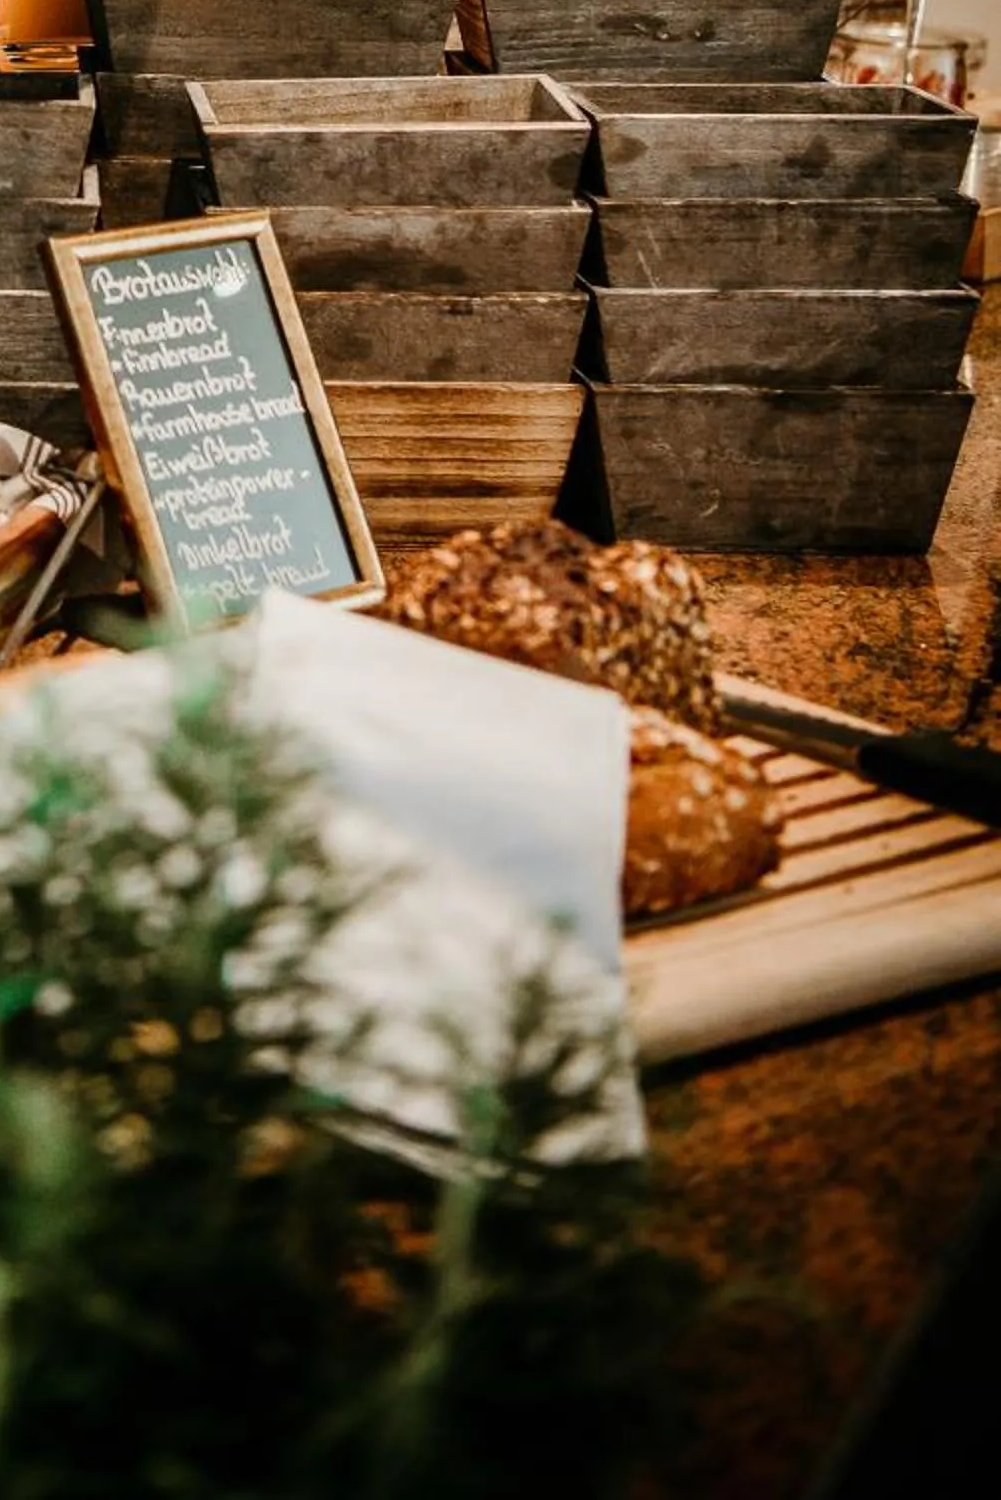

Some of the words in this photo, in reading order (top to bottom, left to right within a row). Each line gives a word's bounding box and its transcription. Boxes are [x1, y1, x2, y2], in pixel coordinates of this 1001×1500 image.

[119, 356, 257, 411] Bauernbrot
[144, 427, 271, 481] Eiweißbrot
[177, 514, 292, 571] Dinkelbrot
